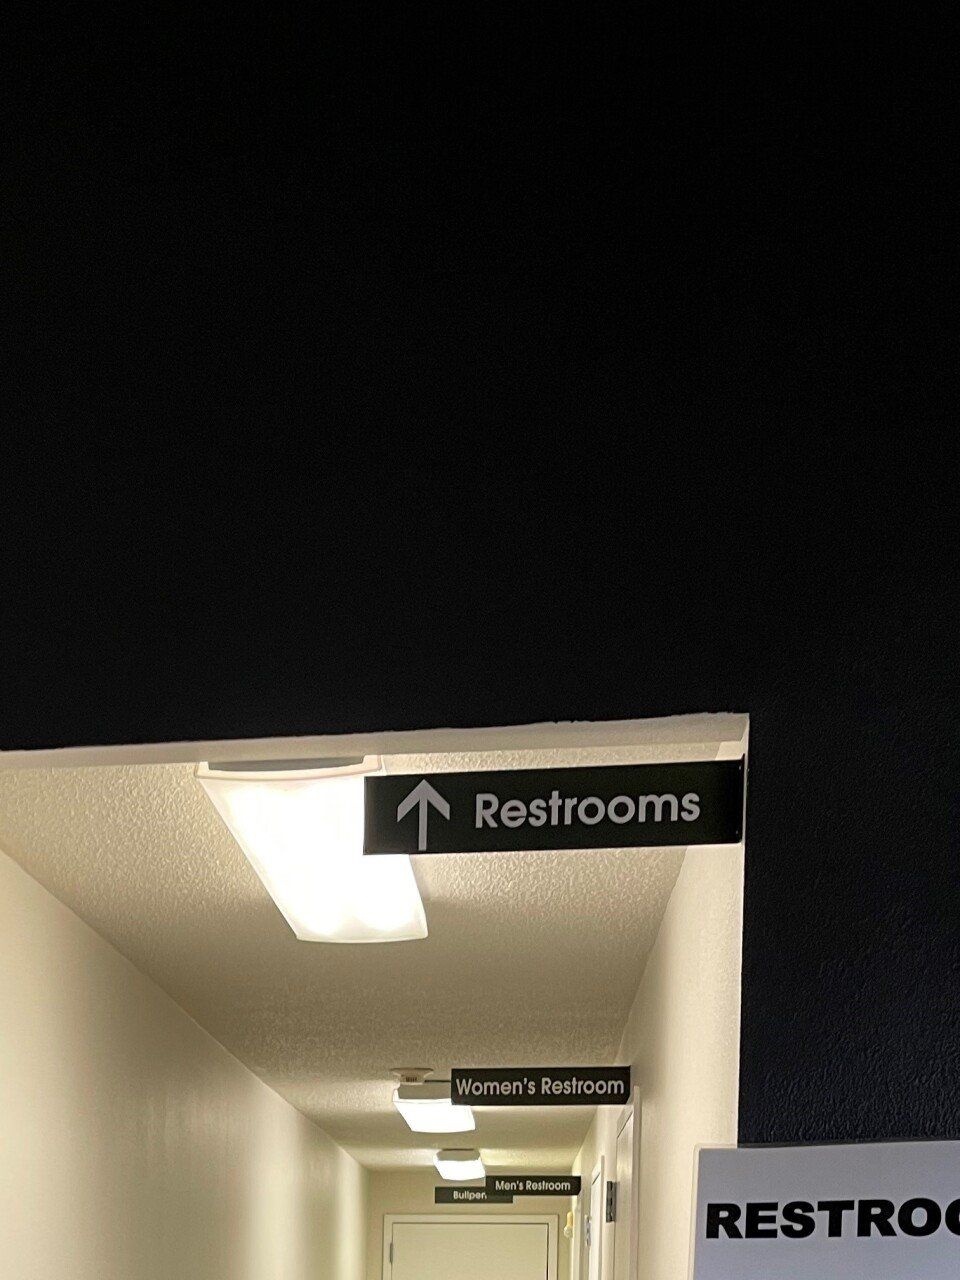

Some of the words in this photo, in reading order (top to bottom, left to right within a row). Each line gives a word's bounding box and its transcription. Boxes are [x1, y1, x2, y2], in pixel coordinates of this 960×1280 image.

[475, 790, 701, 829] Restrooms
[456, 1077, 536, 1096] Women's
[541, 1076, 624, 1095] Restroom
[495, 1180, 524, 1191] Men's
[525, 1180, 571, 1191] Restroom
